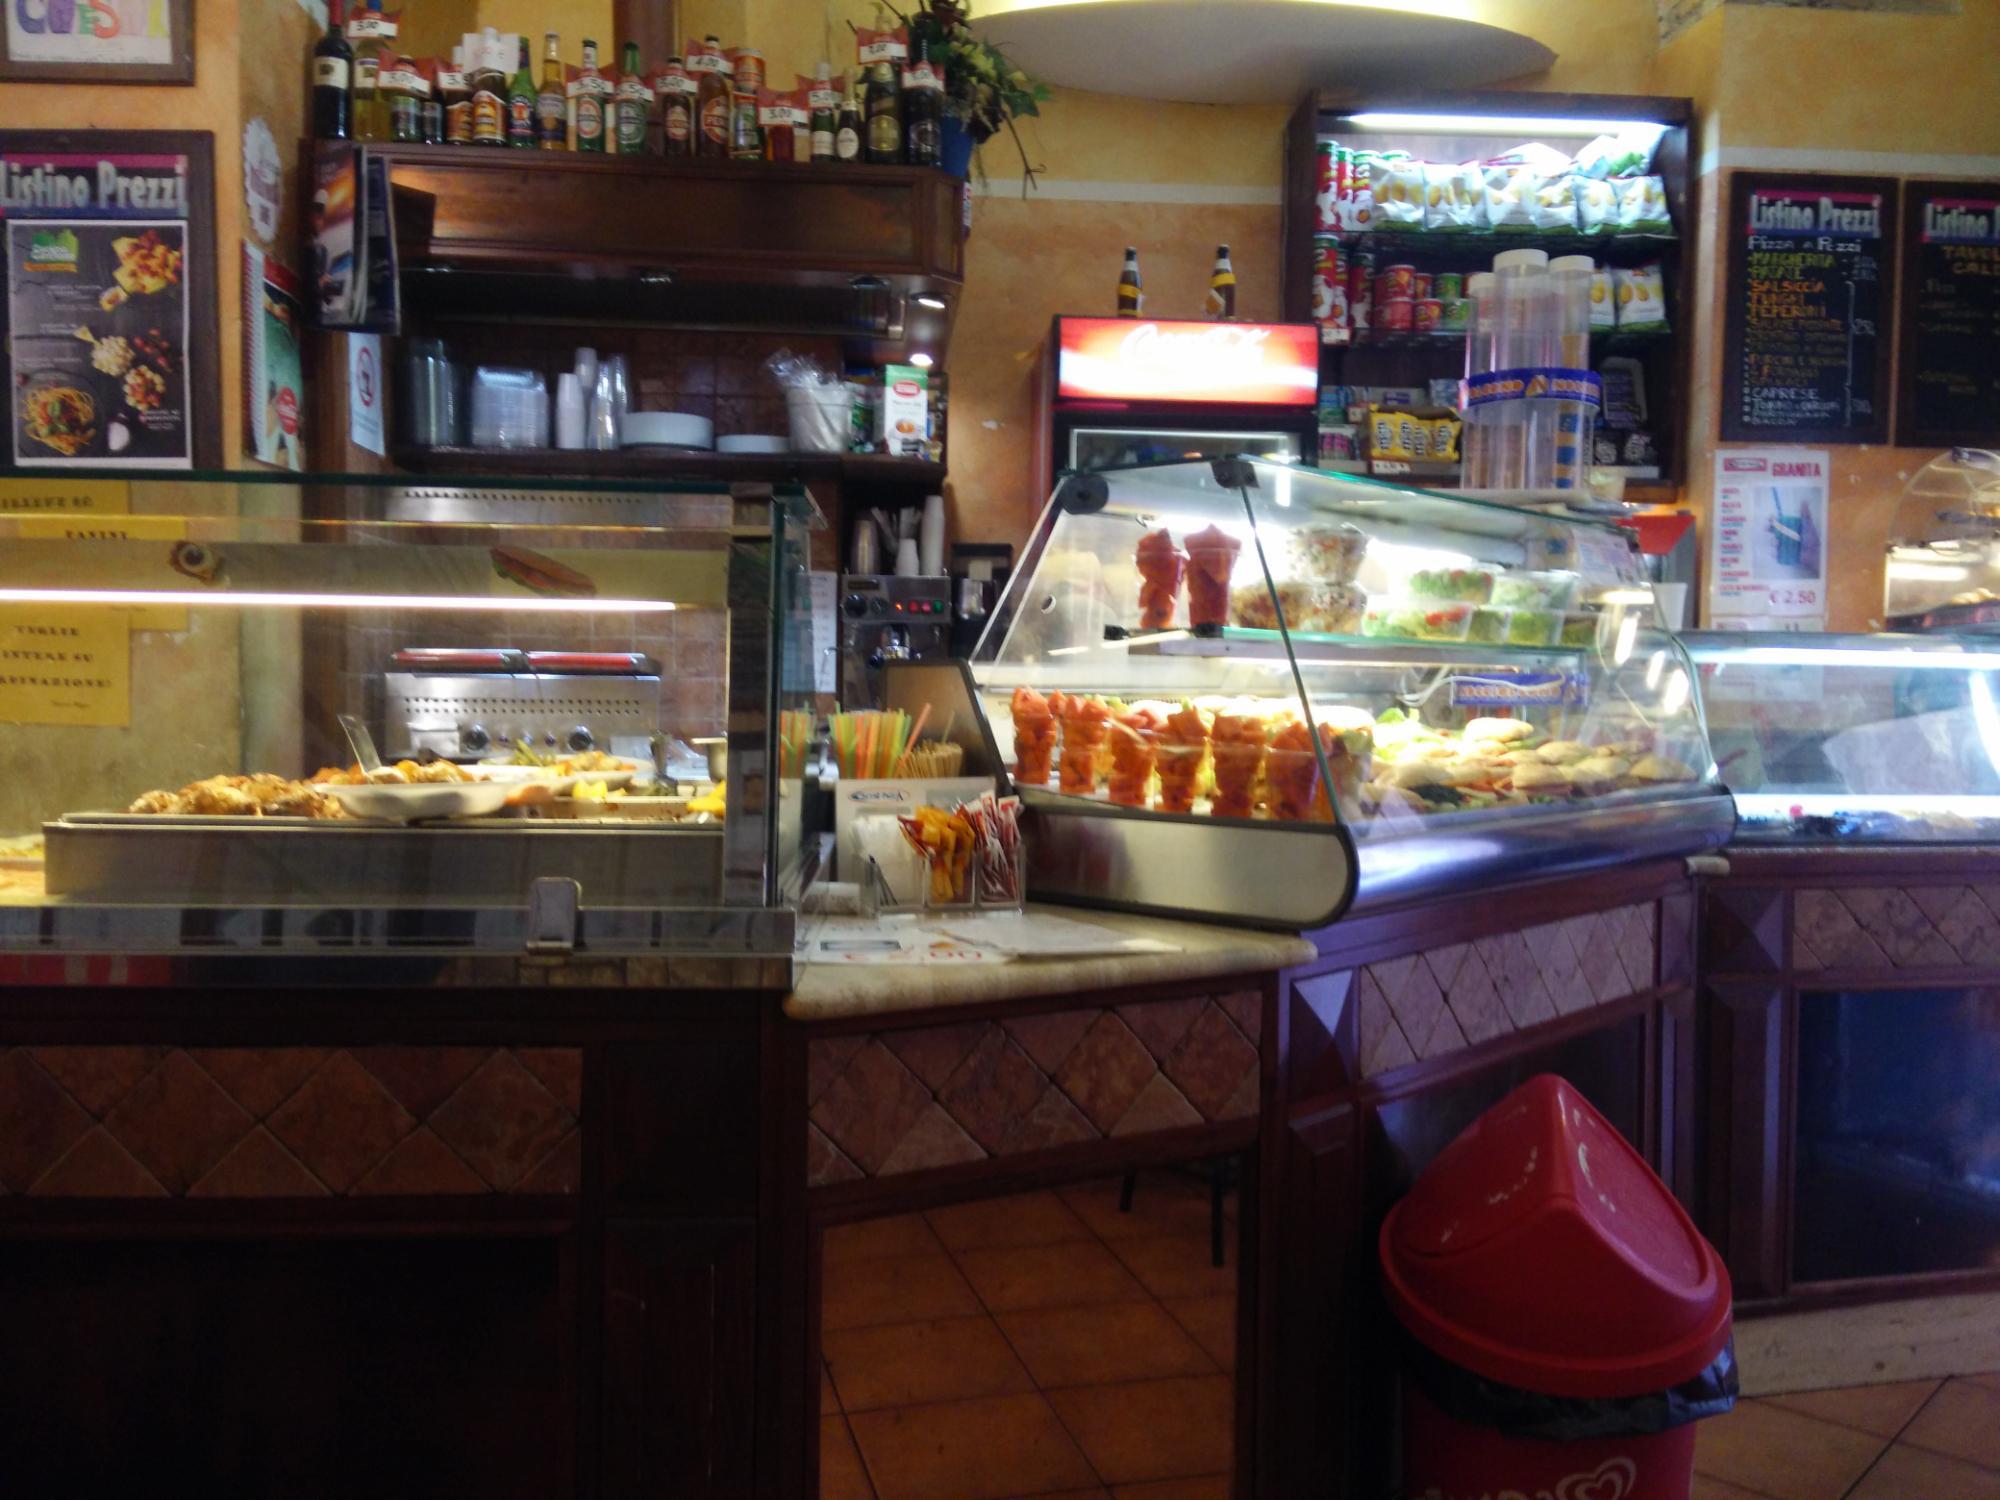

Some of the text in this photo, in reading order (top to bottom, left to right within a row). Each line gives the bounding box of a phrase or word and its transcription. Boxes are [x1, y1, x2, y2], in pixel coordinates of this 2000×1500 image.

[0, 160, 90, 208] Listino
[97, 155, 188, 217] Prezzi
[1750, 194, 1881, 237] Listino Prezzi
[1925, 203, 1990, 239] Listino
[1772, 462, 1821, 477] GRANITA
